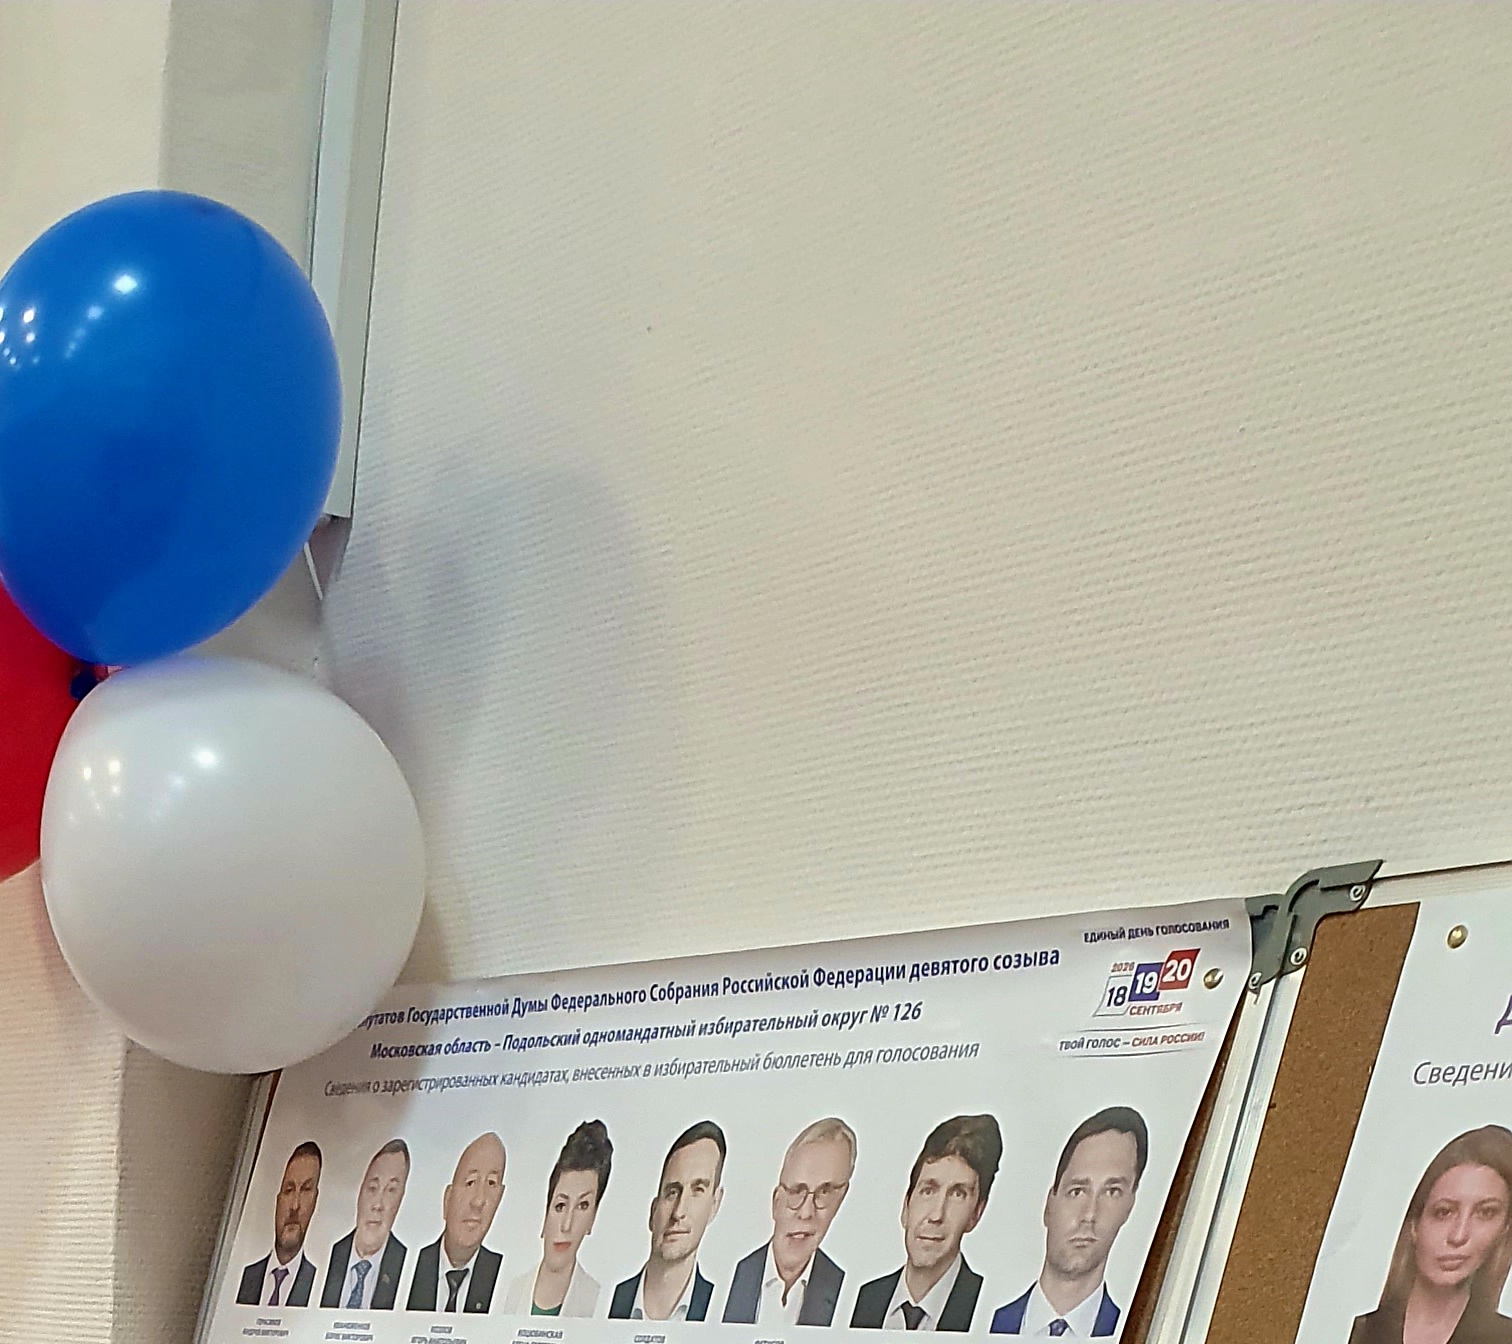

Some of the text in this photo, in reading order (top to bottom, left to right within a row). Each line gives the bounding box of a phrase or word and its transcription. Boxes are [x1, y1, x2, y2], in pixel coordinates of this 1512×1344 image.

[1083, 918, 1230, 944] ЕДИНЫЙ ДЕНЬ ГОЛОСОВАНИЯ
[357, 949, 1060, 1031] утатов Государственной Думы Федерального Собрания Российской Федерации девятого созыва
[1106, 958, 1192, 1007] 18 19 20
[1129, 1002, 1183, 1016] СЕНТЯБРЯ
[369, 1042, 444, 1059] Московская
[443, 1036, 492, 1056] область
[502, 1027, 582, 1053] Подольский
[582, 1019, 697, 1048] одномандатный
[697, 1009, 820, 1039] избирательный
[820, 1009, 869, 1032] округ
[869, 1004, 890, 1024] №
[892, 1000, 924, 1022] 126
[1059, 1037, 1085, 1052] ТВОЙ
[1086, 1036, 1121, 1050] ГОЛОС
[1131, 1034, 1159, 1048] СИЛА
[371, 1080, 381, 1097] о
[380, 1070, 499, 1097] зарегистрированных
[499, 1068, 570, 1089] кандидатах,
[571, 1064, 643, 1082] внесенных
[642, 1063, 653, 1081] в
[653, 1052, 762, 1081] избирательный
[759, 1050, 842, 1072] бюллетень
[842, 1049, 874, 1070] для
[875, 1042, 981, 1065] голосования
[1413, 1061, 1512, 1087] Сведени
